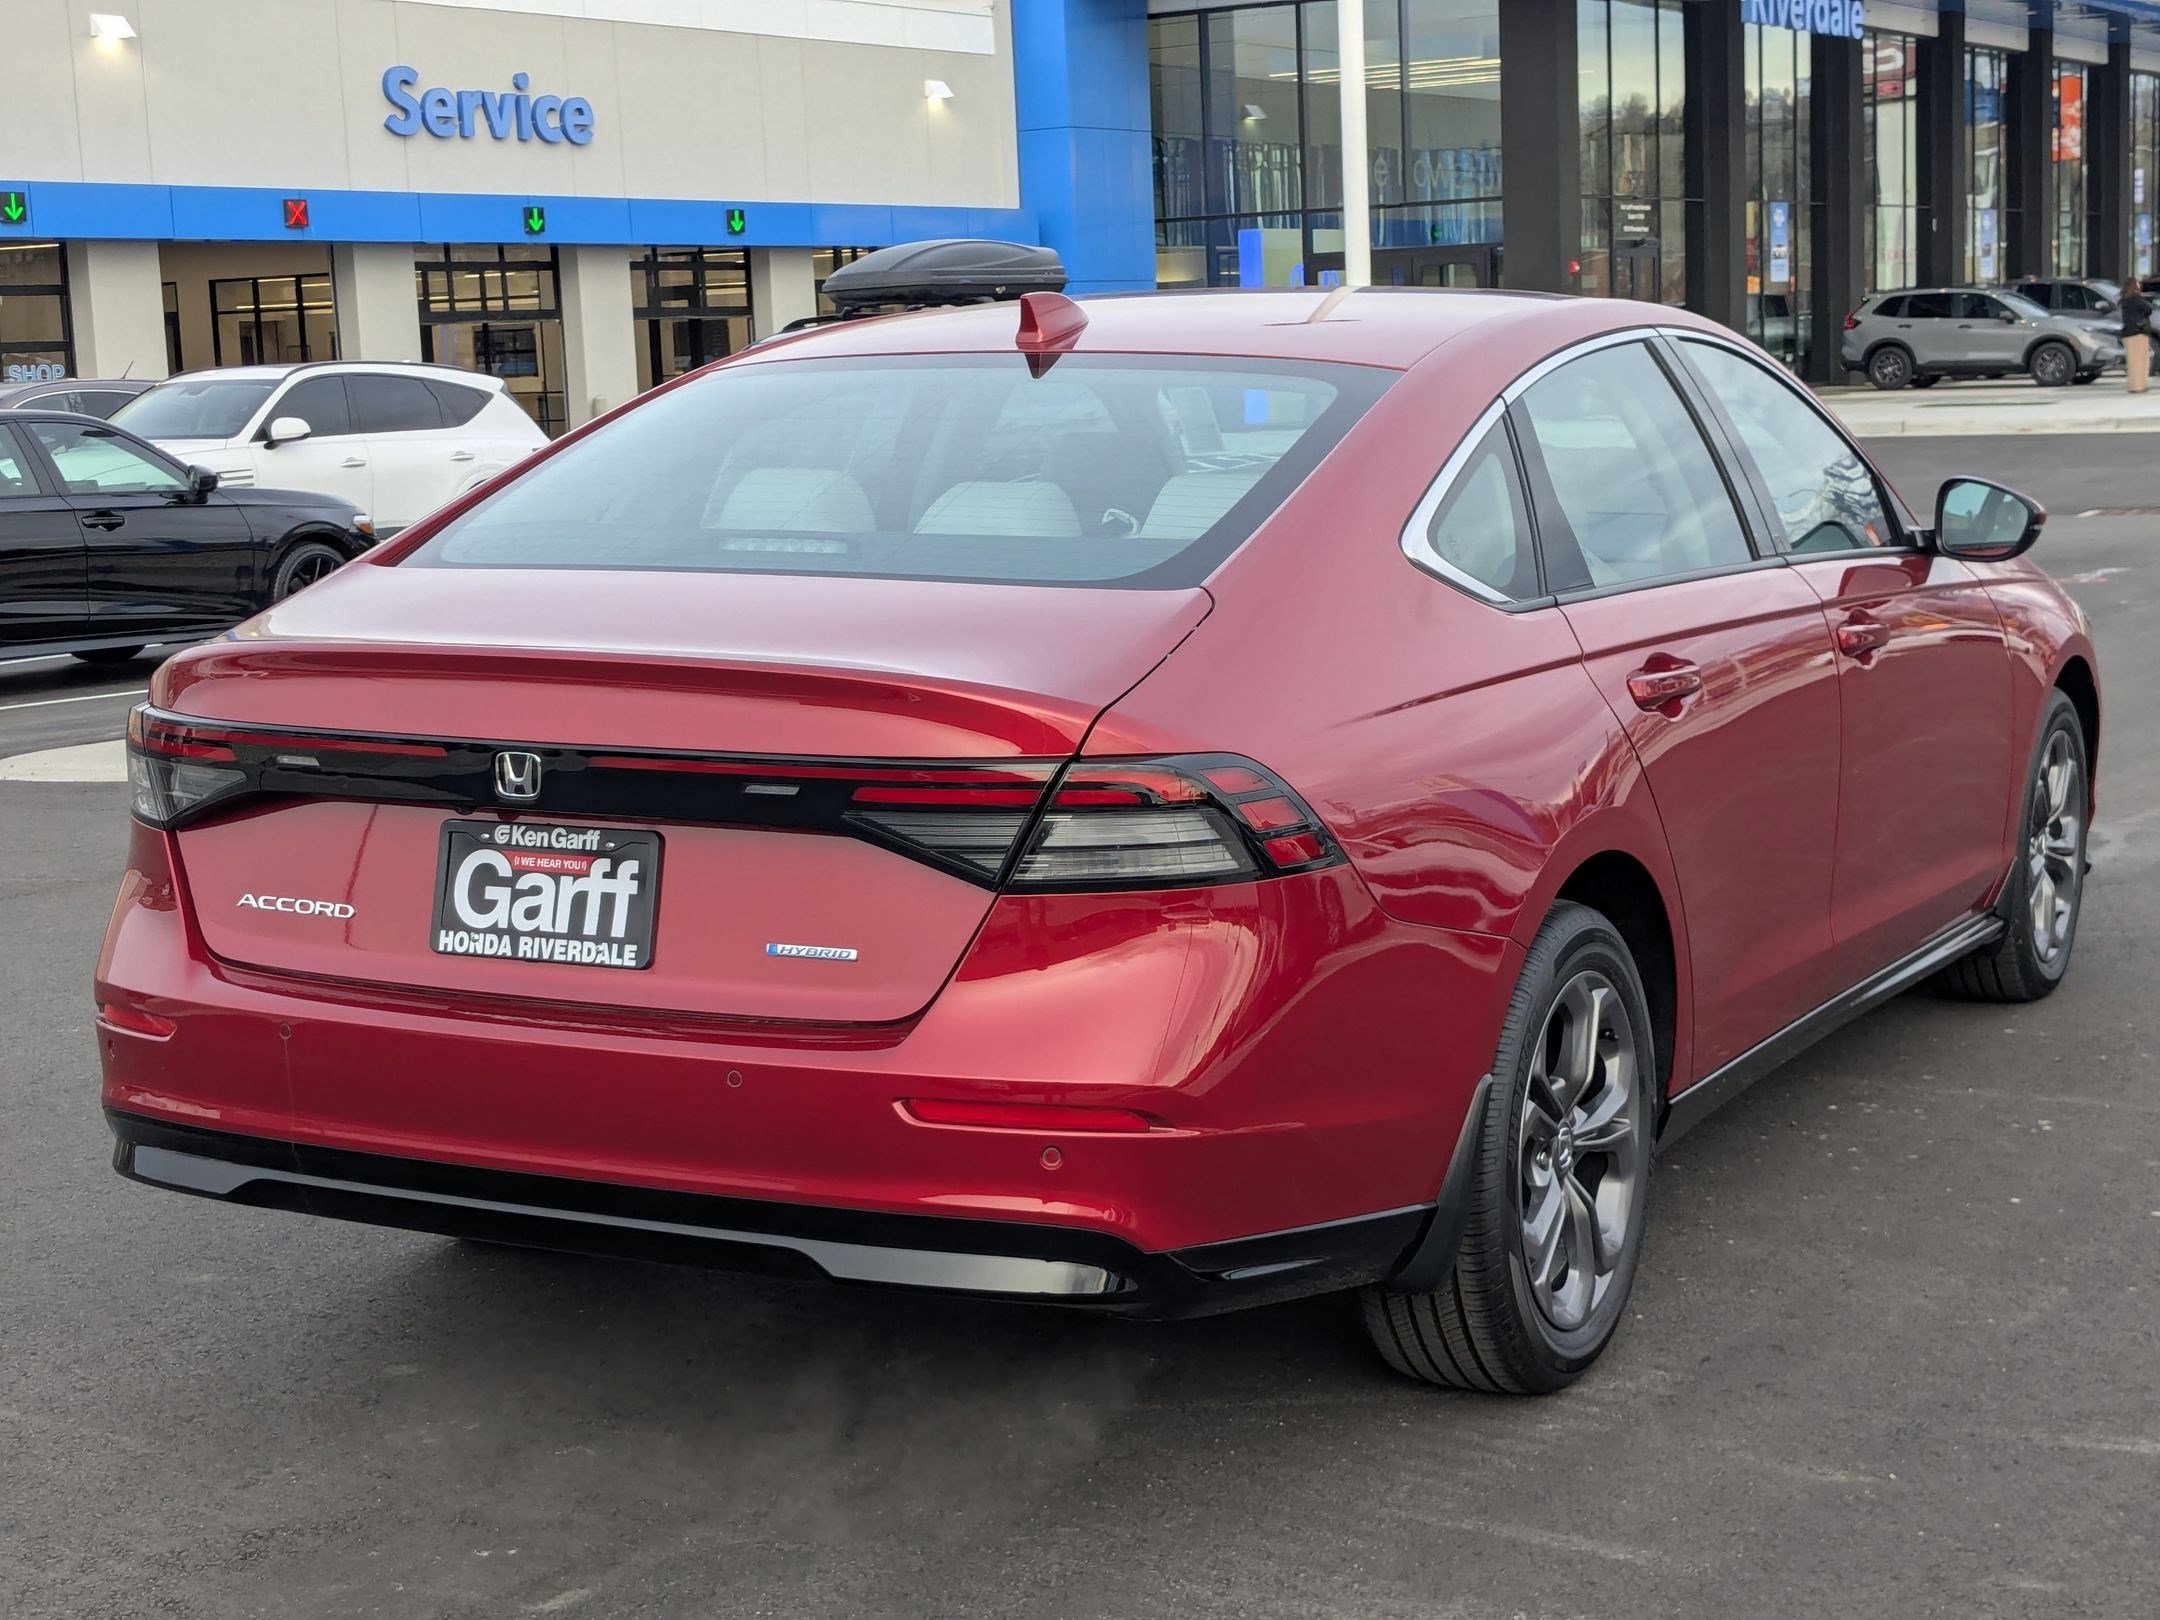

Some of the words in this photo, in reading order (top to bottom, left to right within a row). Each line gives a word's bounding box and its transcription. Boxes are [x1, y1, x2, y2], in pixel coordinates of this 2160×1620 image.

[382, 65, 594, 145] Service
[8, 364, 66, 383] SHOP
[511, 825, 549, 847] Ken
[551, 827, 601, 851] Garff
[521, 856, 536, 867] WE
[537, 858, 562, 868] HEAR
[563, 860, 581, 870] YOU
[236, 893, 355, 919] ACCORD
[454, 849, 640, 938] Garff
[438, 930, 511, 957] HONDA
[518, 937, 638, 967] RIVERDALE
[780, 946, 852, 959] HYBRID
